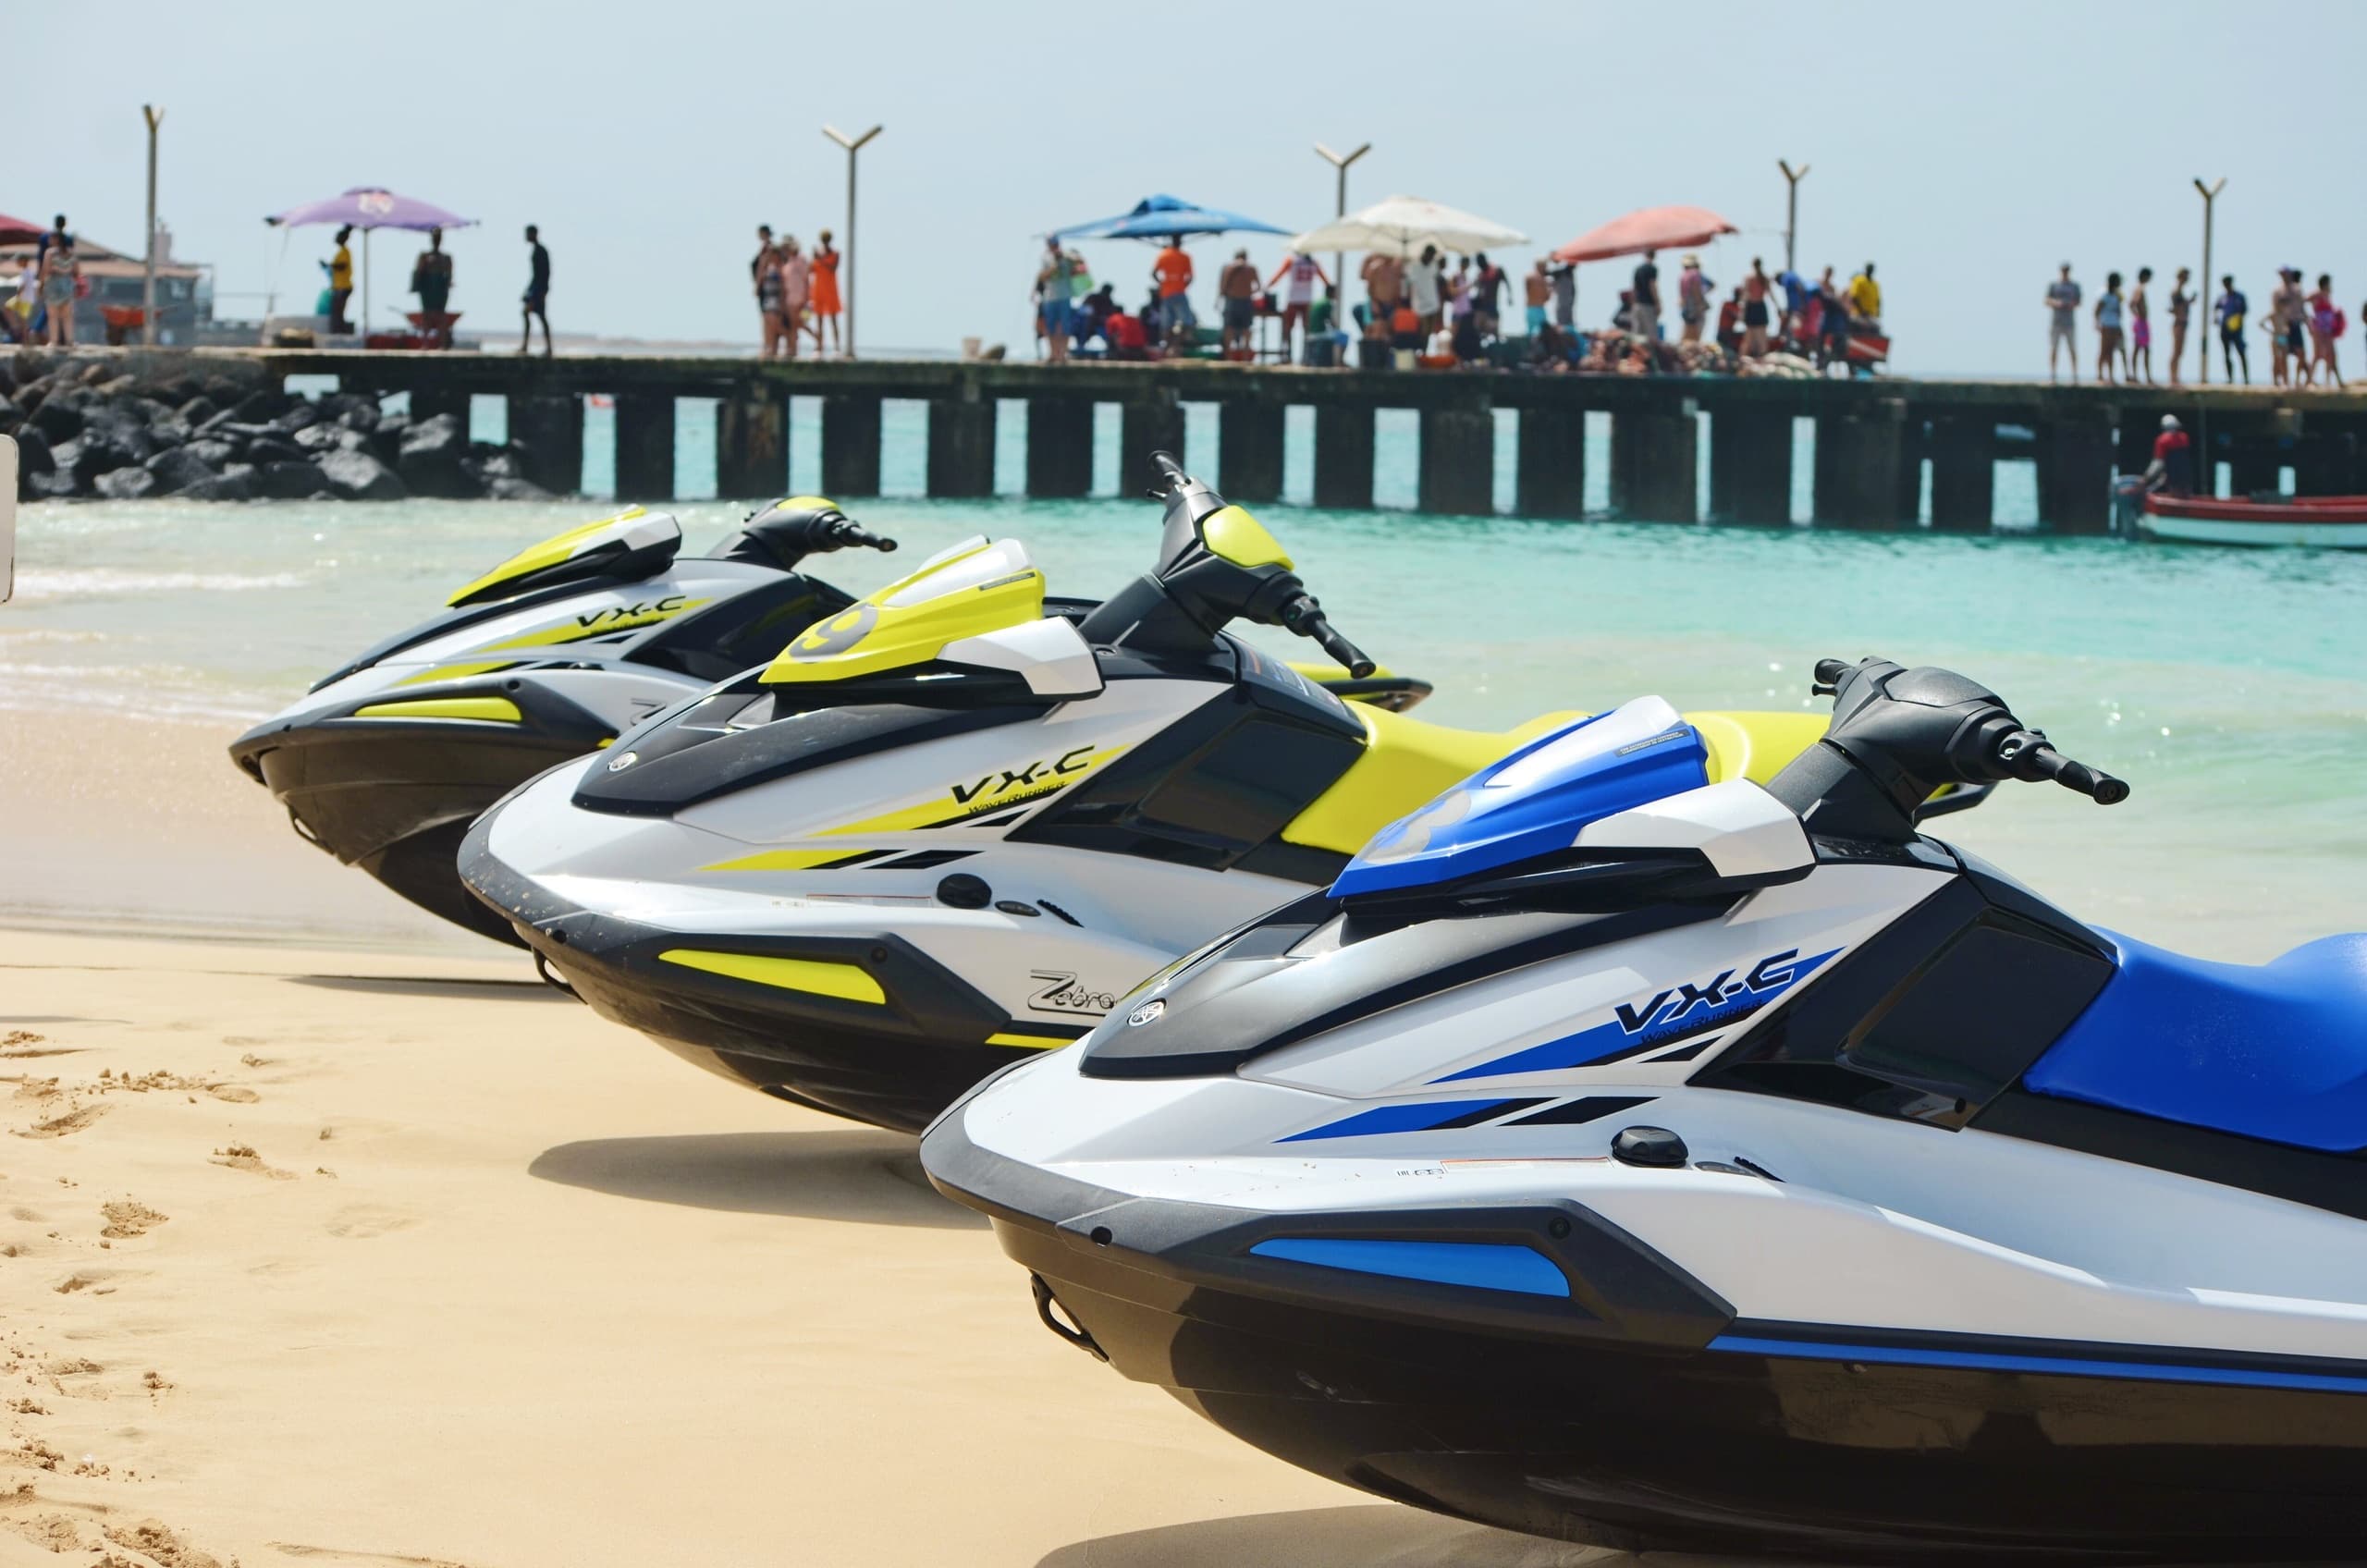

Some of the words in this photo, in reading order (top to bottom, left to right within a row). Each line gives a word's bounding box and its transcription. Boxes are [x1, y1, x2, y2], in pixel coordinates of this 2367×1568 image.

[577, 595, 686, 627] VX-C
[789, 603, 878, 665] 9
[951, 745, 1095, 804] VX-C
[1614, 948, 1799, 1035] VX-C
